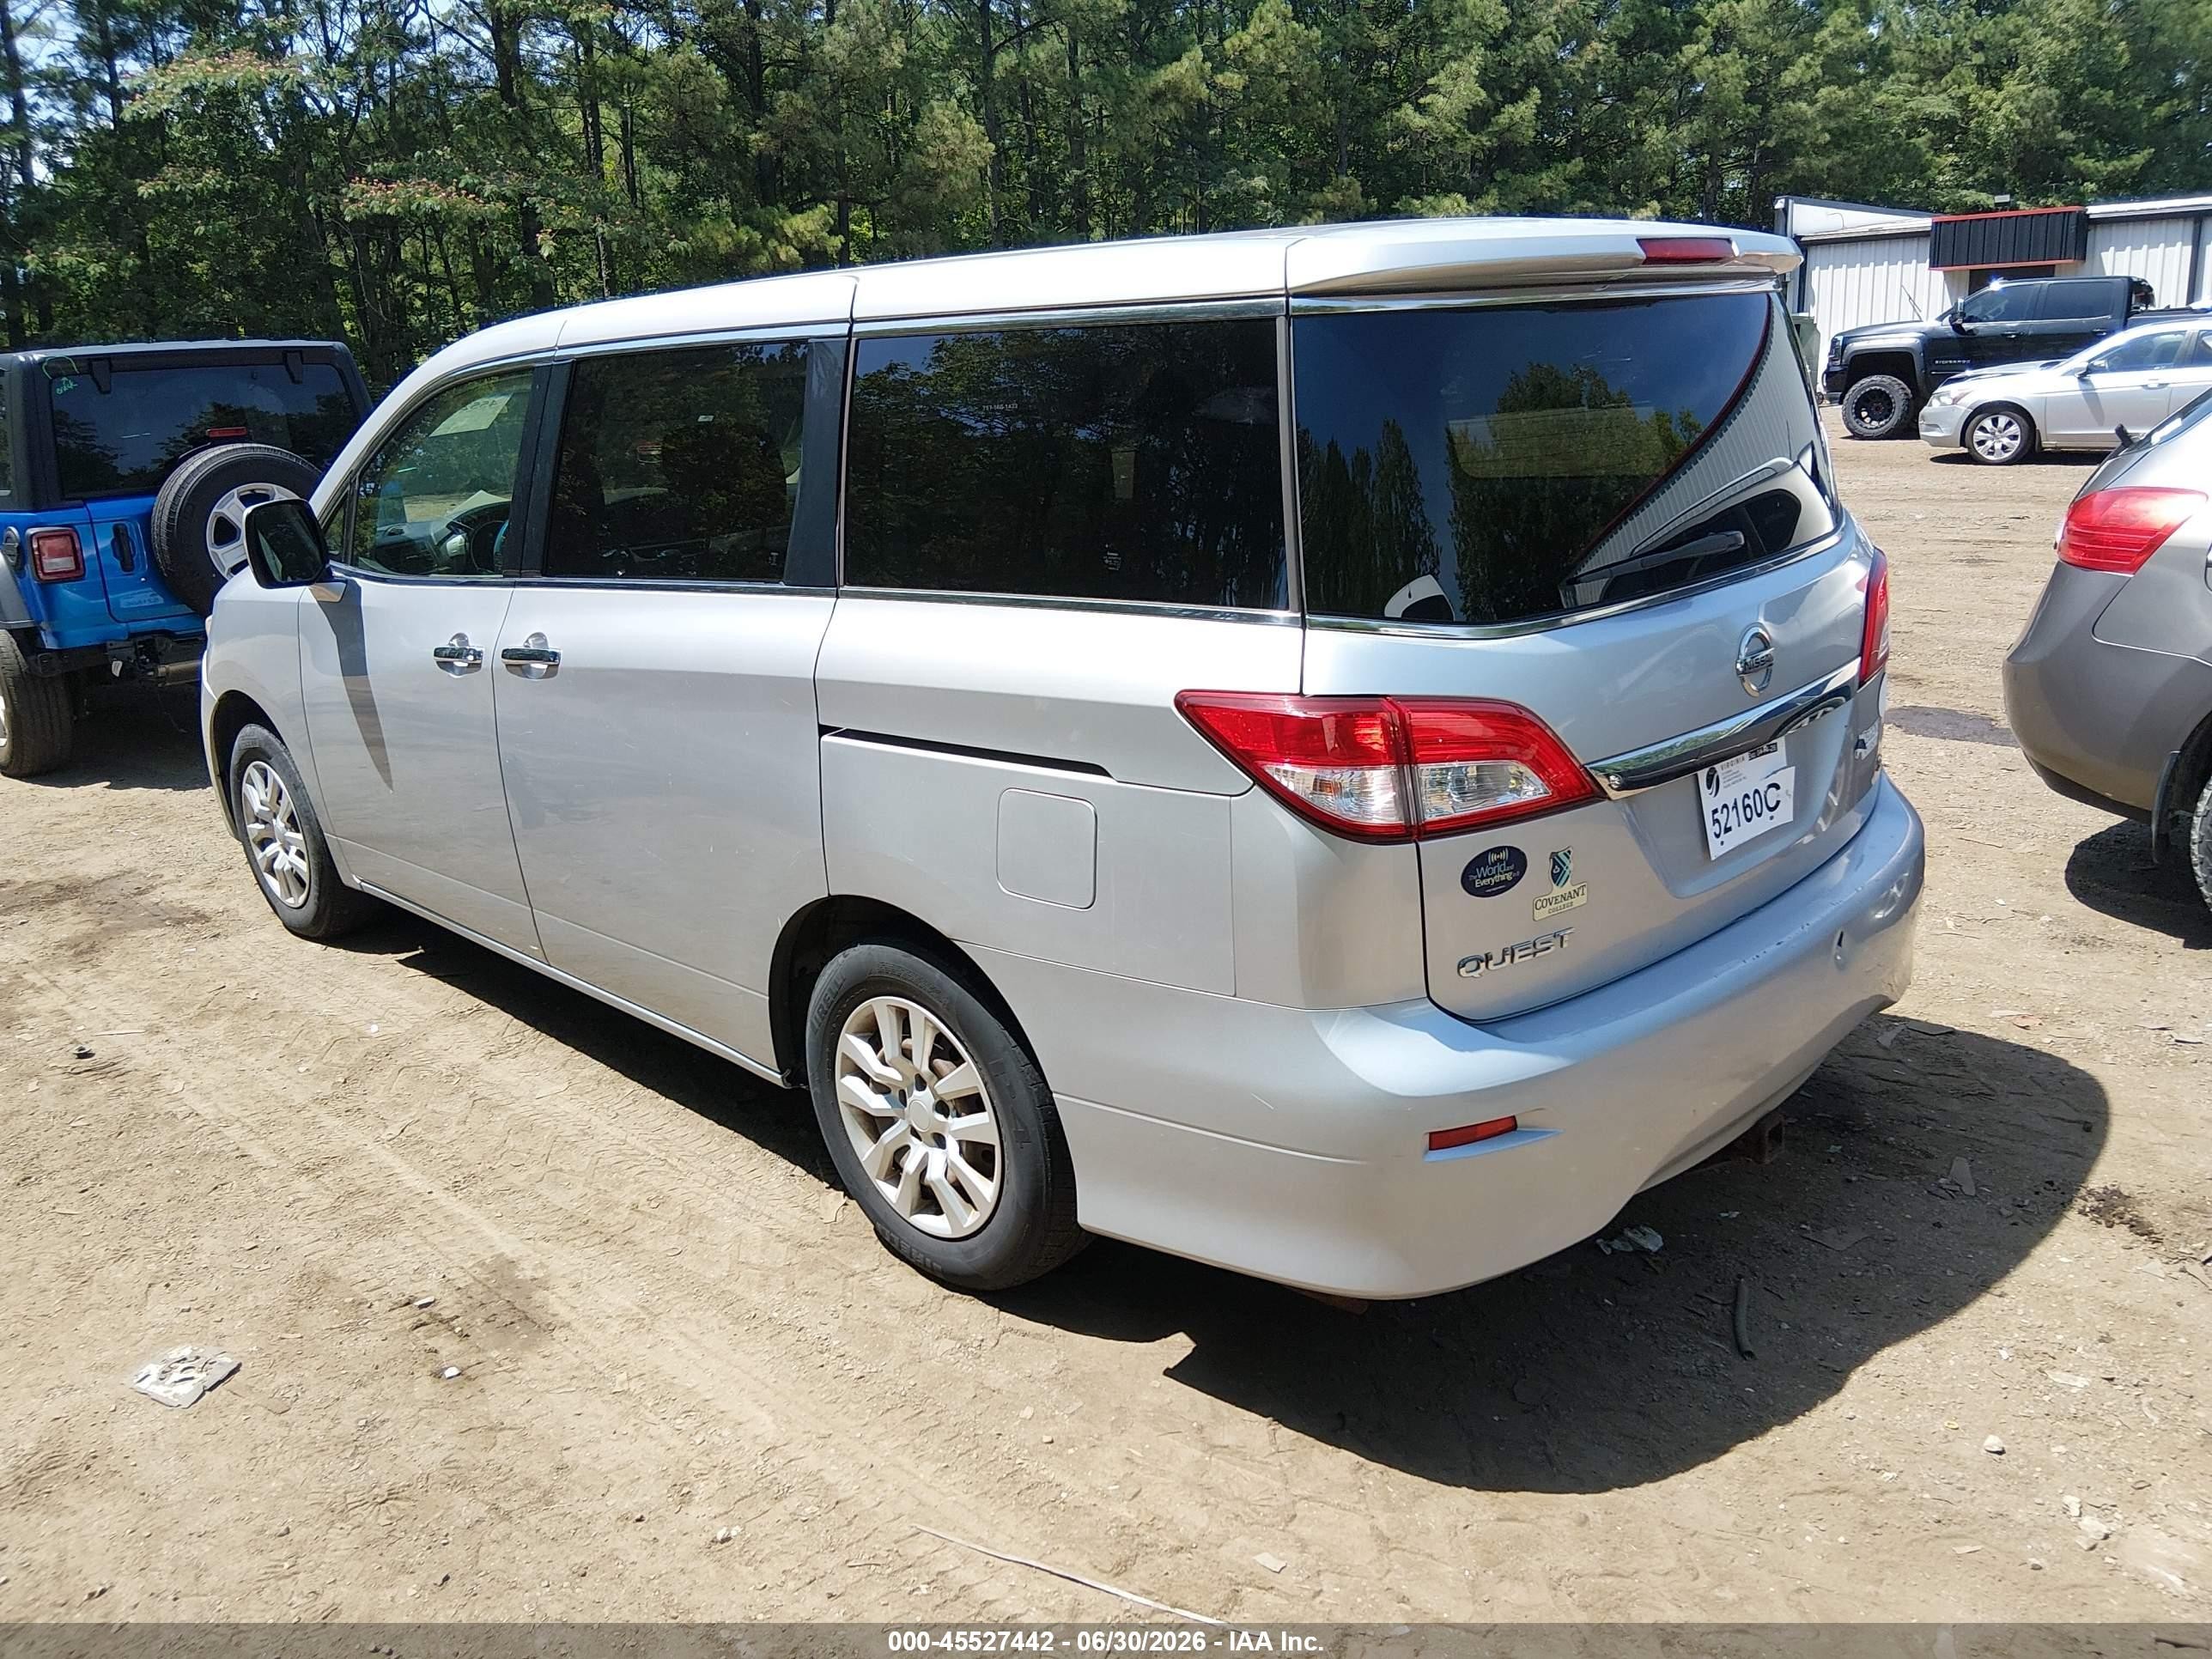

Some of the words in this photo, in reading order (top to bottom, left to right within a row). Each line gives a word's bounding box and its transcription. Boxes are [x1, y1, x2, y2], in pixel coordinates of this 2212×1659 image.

[1744, 654, 1772, 670] NISS
[1711, 782, 1781, 839] 52160C
[1474, 872, 1513, 888] Everything
[1476, 861, 1506, 878] World
[1534, 884, 1586, 911] COVENANT
[1457, 927, 1576, 978] QUEST
